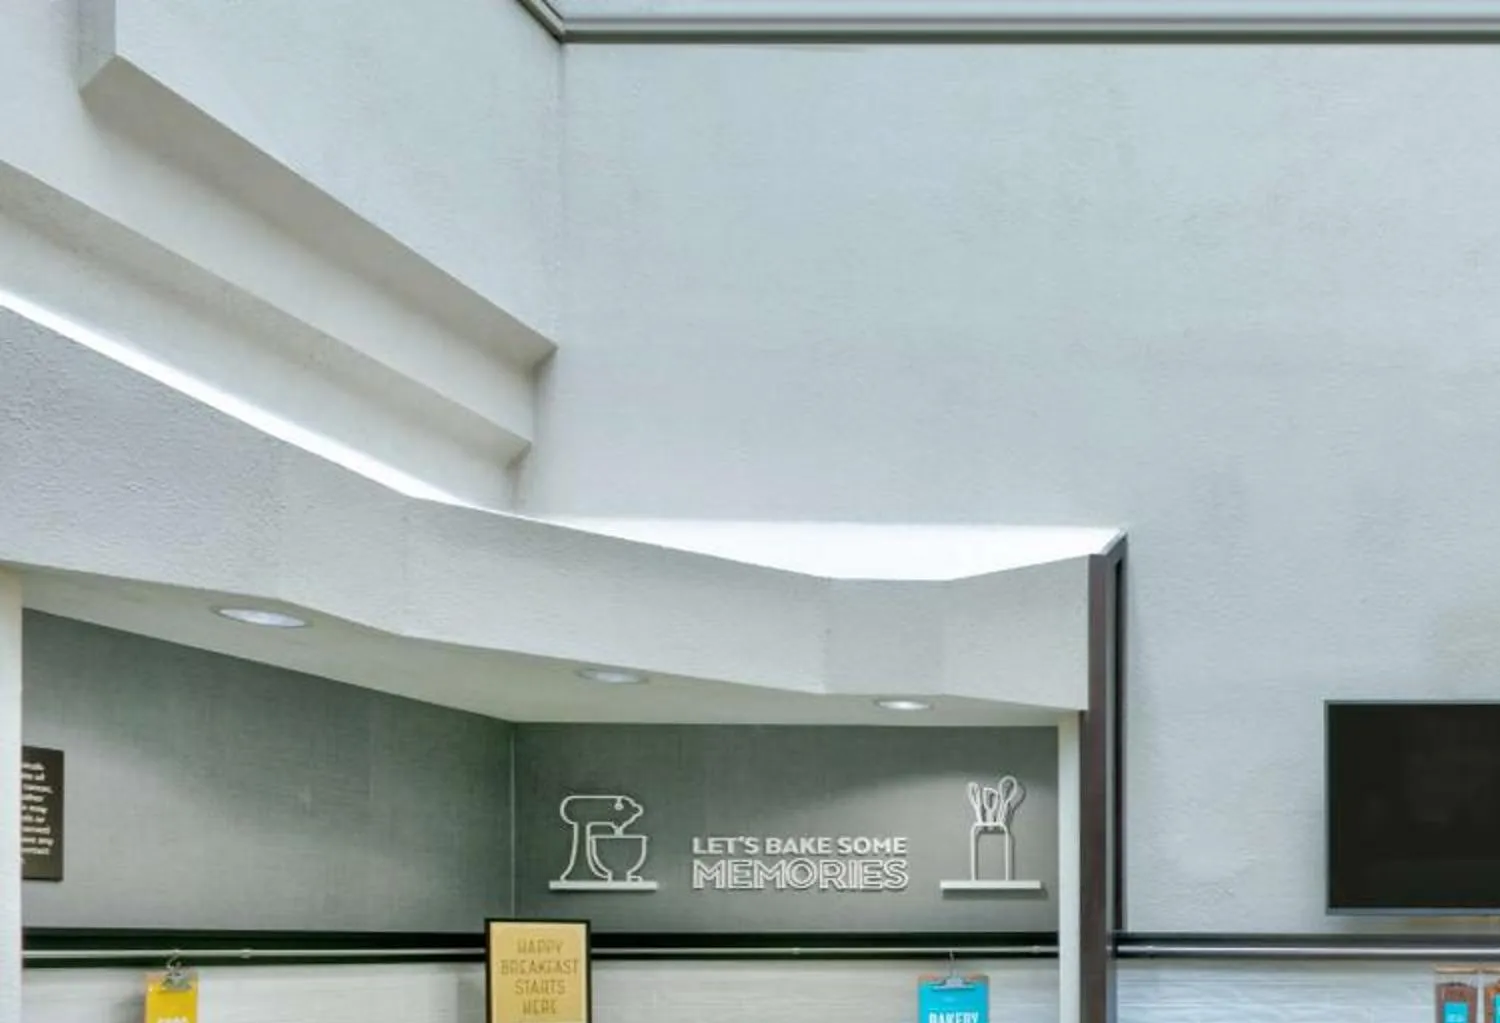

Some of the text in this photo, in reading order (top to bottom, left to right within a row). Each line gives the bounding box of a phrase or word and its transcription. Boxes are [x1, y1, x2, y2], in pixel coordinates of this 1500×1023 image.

[692, 836, 909, 855] LET'S BAKE SOME
[692, 857, 909, 890] MEMORIES
[517, 938, 565, 954] HAPPY
[500, 958, 578, 976] BREAKFAST
[514, 979, 566, 996] STARTS
[522, 998, 557, 1015] HERE
